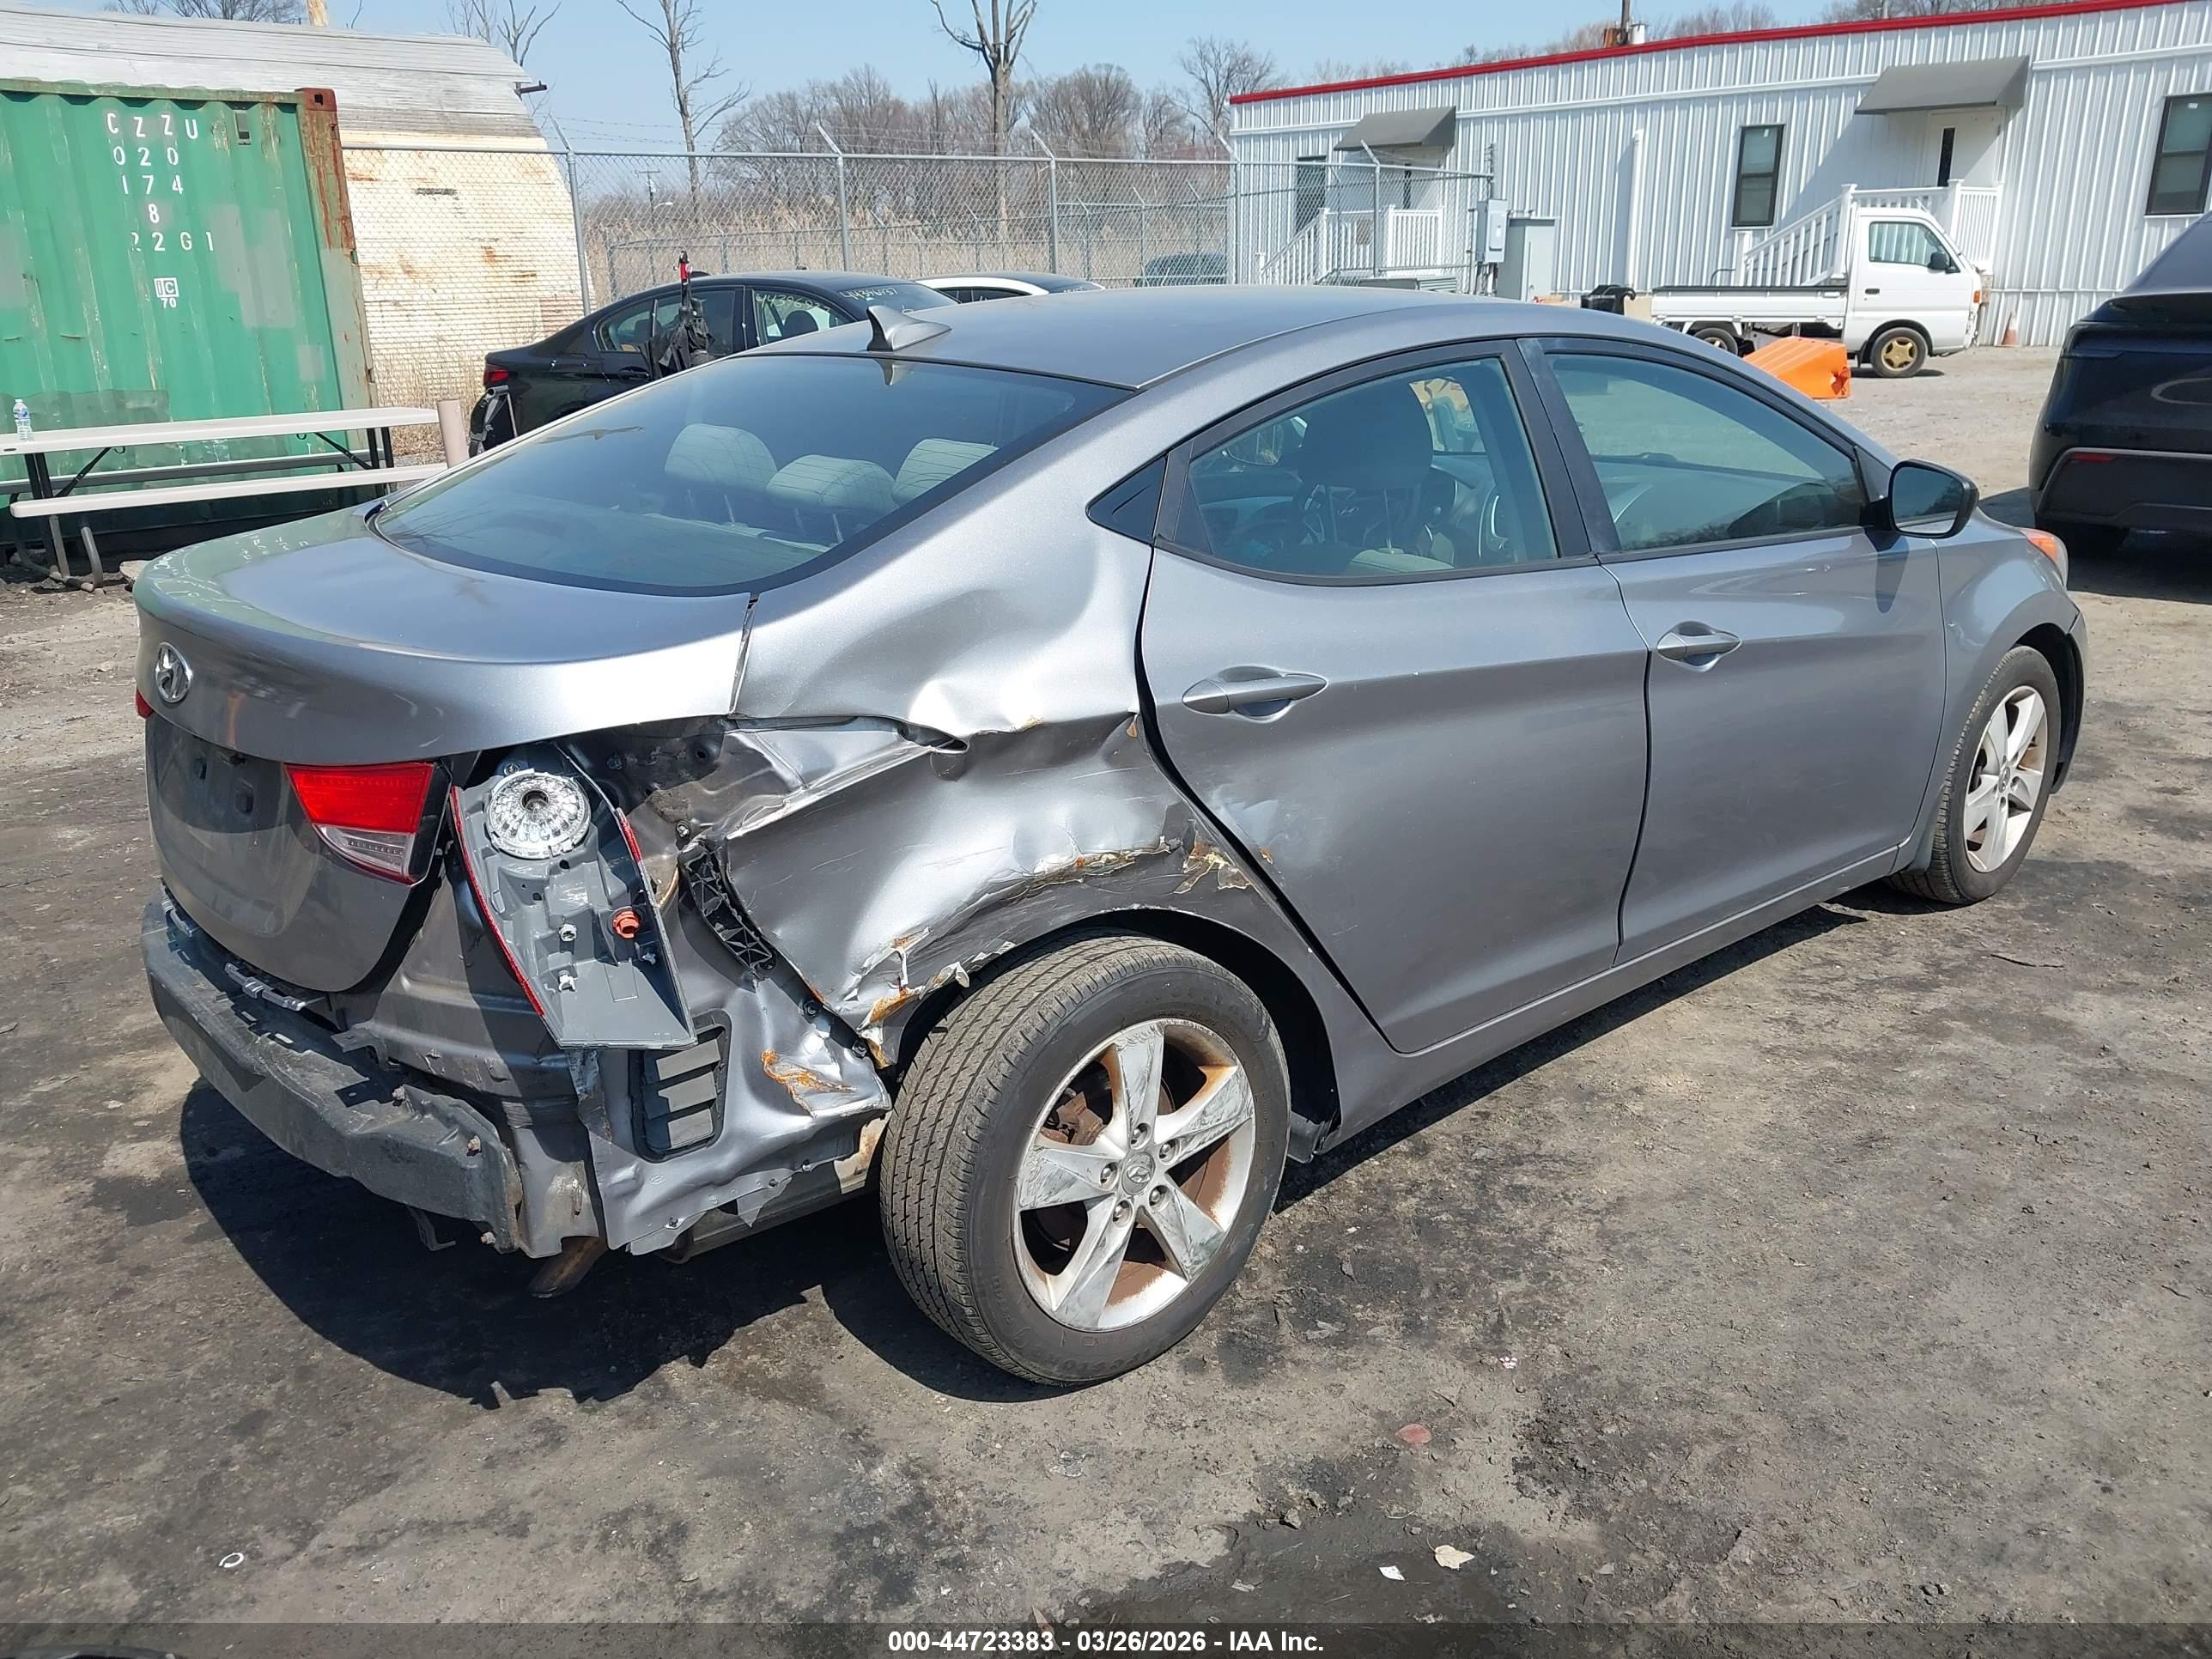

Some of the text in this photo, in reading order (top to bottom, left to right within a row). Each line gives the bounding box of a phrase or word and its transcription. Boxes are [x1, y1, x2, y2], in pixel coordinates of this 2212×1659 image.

[106, 112, 198, 138] CZZU
[112, 145, 179, 166] 020
[121, 173, 184, 195] 174
[147, 203, 160, 223] 8
[161, 297, 177, 308] 70
